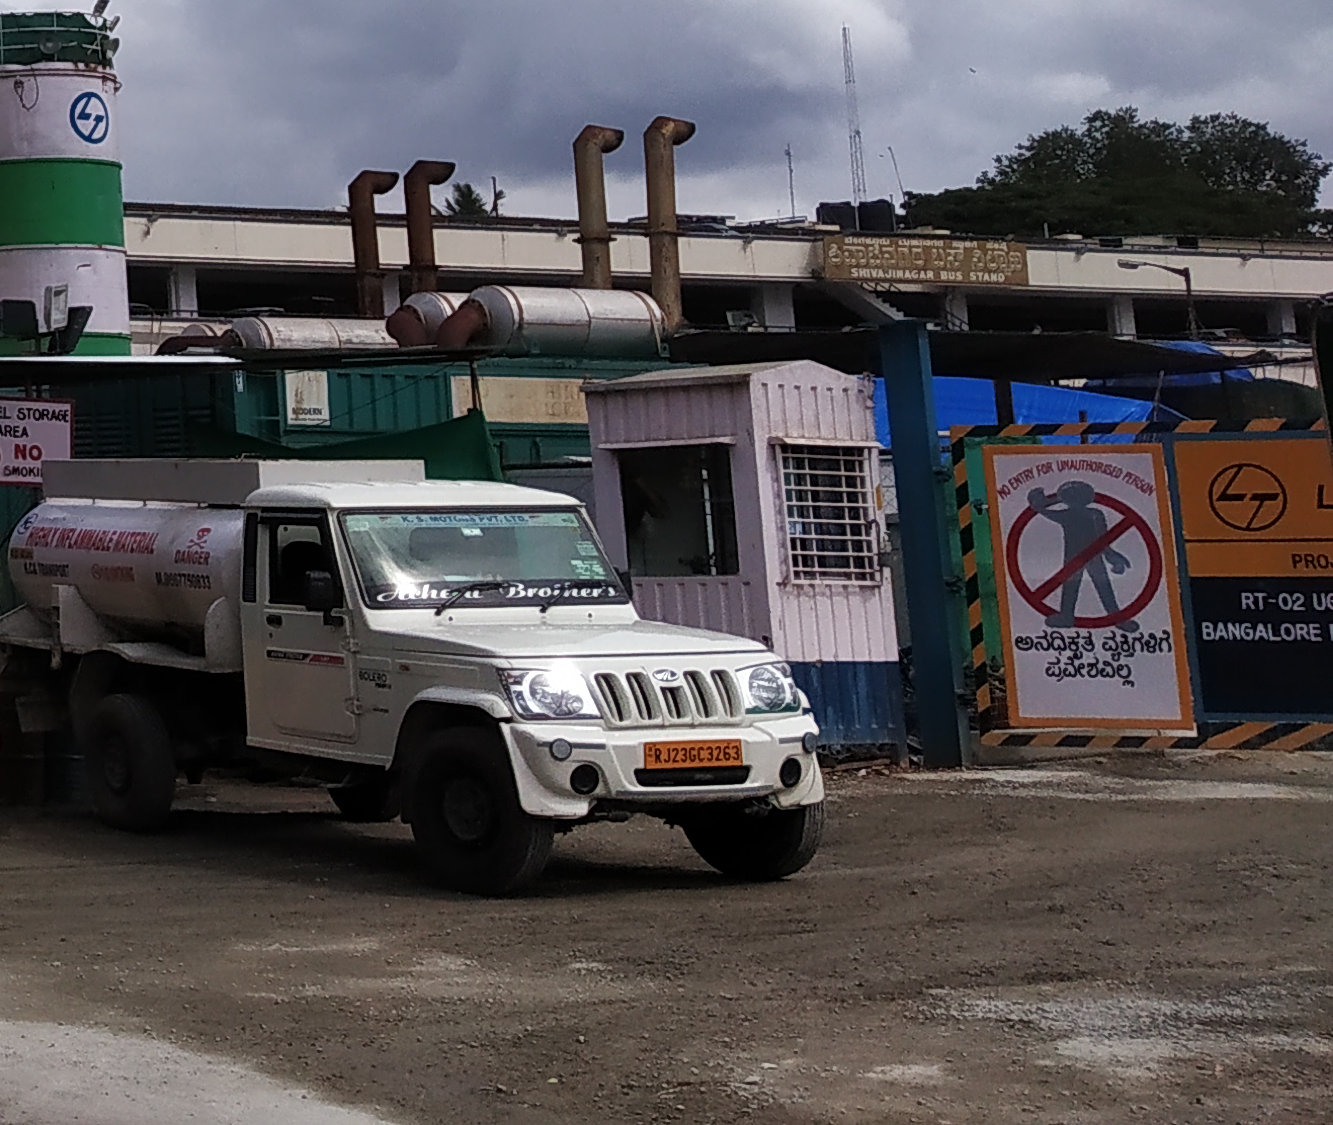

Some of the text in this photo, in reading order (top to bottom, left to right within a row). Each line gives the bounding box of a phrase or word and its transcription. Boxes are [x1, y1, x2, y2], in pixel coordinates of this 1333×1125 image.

[828, 244, 925, 266] ಶಿವಾಜಿನಗರ
[931, 247, 964, 269] ಬಸ್
[850, 268, 1006, 282] SHIVAJINAGAR BUS STAND
[16, 407, 70, 423] STORAGE
[14, 443, 43, 461] NO
[3, 465, 43, 478] SMOKI
[997, 459, 1155, 500] NO ENTRY FOR UNAUTHORISED PERSON
[26, 526, 159, 554] HIGHLY INFLAMMABLE MATERIAL
[174, 549, 211, 565] DANGER
[1241, 592, 1307, 611] RT-02
[1201, 622, 1324, 642] BANGALORE
[1015, 630, 1173, 662] ಅನಧಿಕೃತ ವ್ಯಕ್ತಿಗಳಿಗೆ
[359, 671, 388, 683] BOLERO
[1045, 656, 1135, 687] ಪ್ರವೇಶವಿಲ್ಲ
[654, 745, 740, 764] RJ23GC3263
